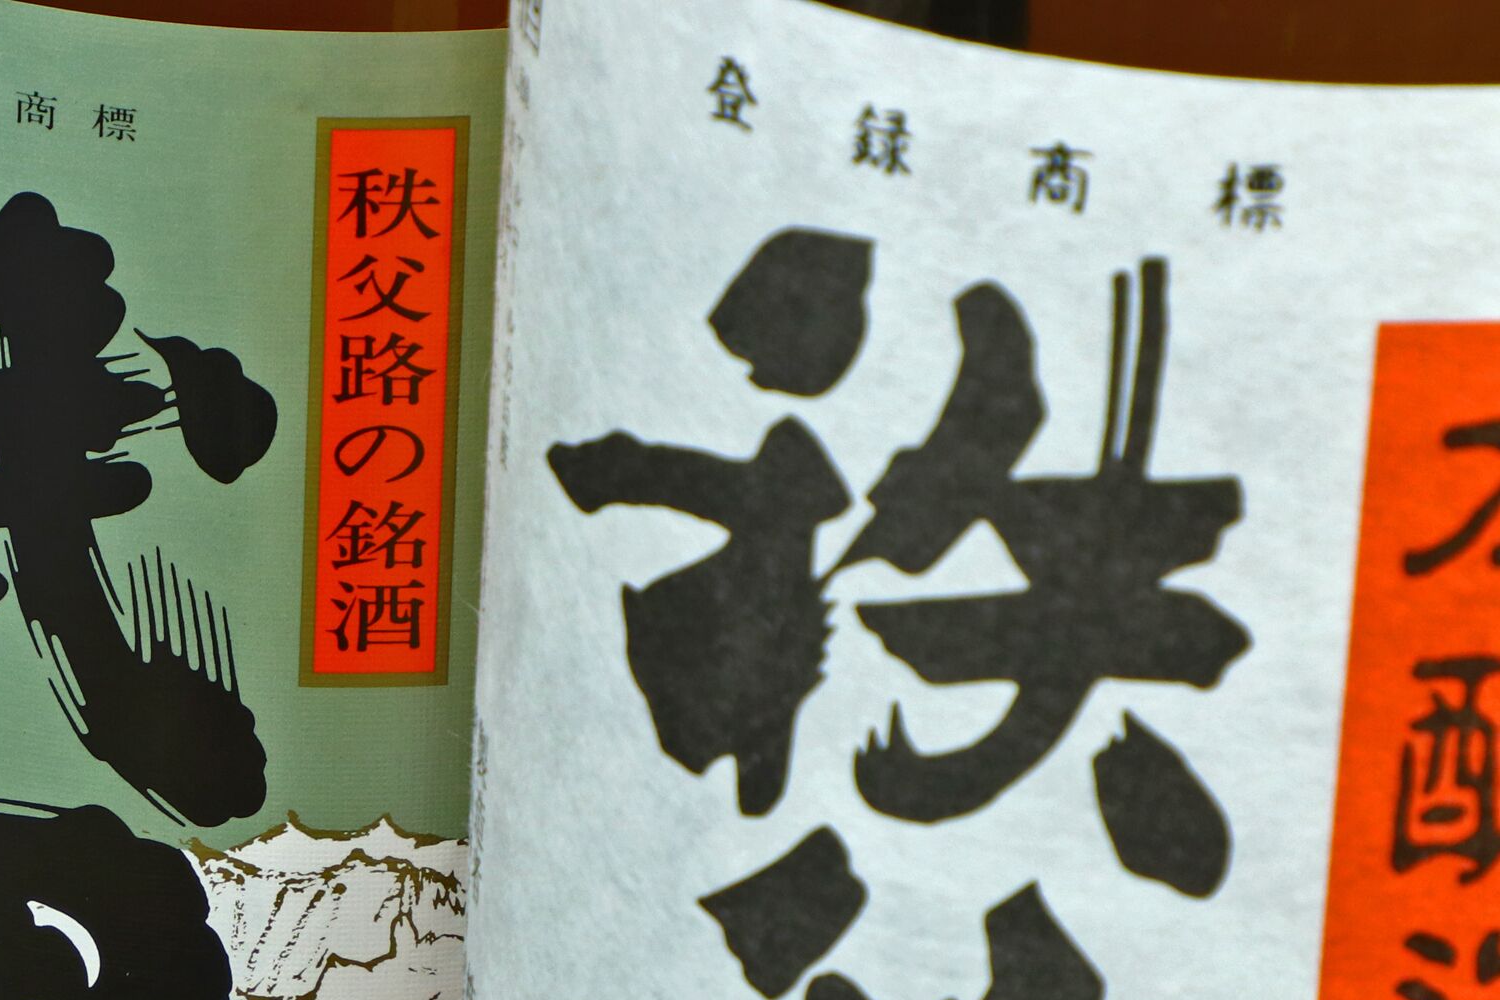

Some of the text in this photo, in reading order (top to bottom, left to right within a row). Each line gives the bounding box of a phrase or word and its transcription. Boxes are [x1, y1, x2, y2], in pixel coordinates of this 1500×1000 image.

[325, 167, 441, 653] 秩父路の銘酒
